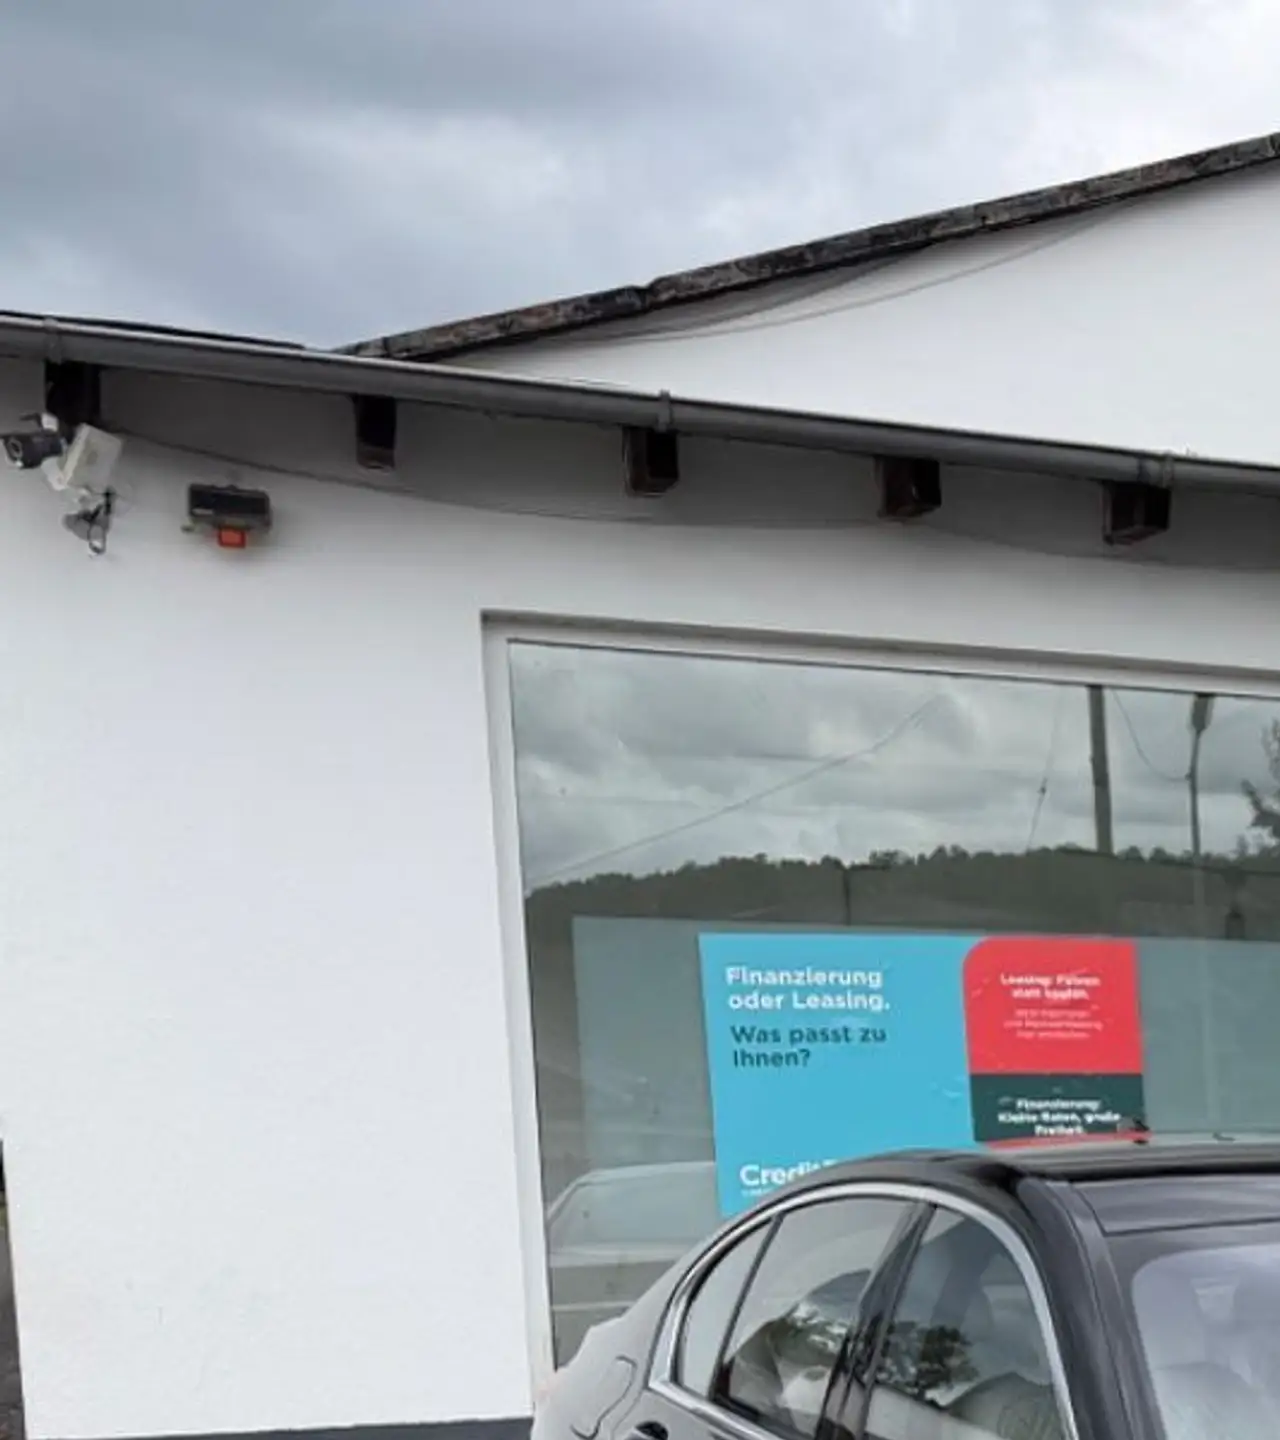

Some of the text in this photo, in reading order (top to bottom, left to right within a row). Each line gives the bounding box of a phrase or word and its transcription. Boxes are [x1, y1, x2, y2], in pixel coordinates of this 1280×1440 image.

[725, 966, 883, 988] Finanzierung
[729, 990, 890, 1012] oder Leasing.
[730, 1025, 887, 1049] Was passt zu
[733, 1048, 811, 1068] Ihnen?
